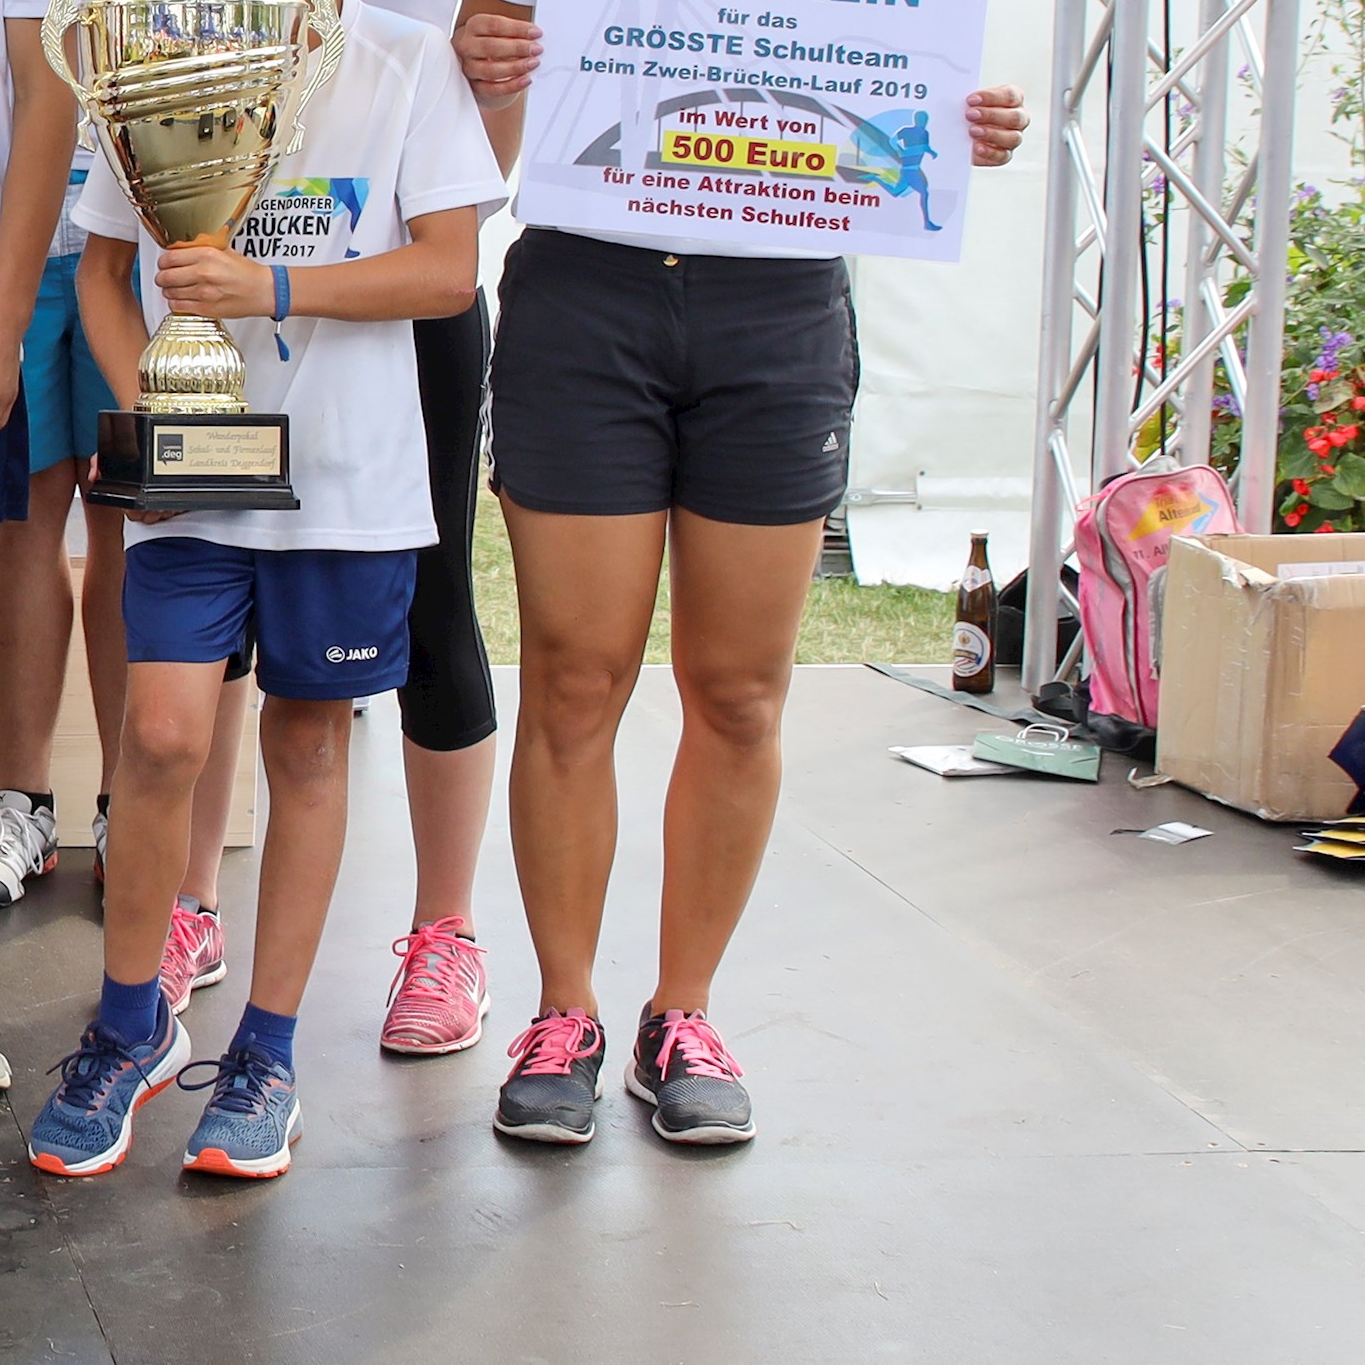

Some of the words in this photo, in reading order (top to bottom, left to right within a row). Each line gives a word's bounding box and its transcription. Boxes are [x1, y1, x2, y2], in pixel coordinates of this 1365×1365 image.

[718, 8, 749, 25] für
[756, 12, 798, 30] das
[604, 25, 744, 56] GRÖSSTE
[753, 38, 909, 70] Schulteam
[580, 56, 636, 76] beim
[642, 61, 863, 95] Zwei-Brücken-Lauf
[869, 80, 929, 100] 2019
[679, 108, 707, 125] im
[714, 111, 769, 132] Wert
[777, 119, 817, 135] von
[672, 135, 735, 162] 500
[747, 142, 825, 172] Euro
[603, 167, 635, 186] für
[642, 173, 691, 190] eine
[697, 176, 816, 201] Attraktion
[824, 187, 881, 207] beim
[627, 198, 734, 220] nächsten
[741, 205, 850, 232] Schulfest
[282, 245, 315, 257] 2017
[161, 450, 182, 460] .deg
[346, 646, 378, 660] JAKO
